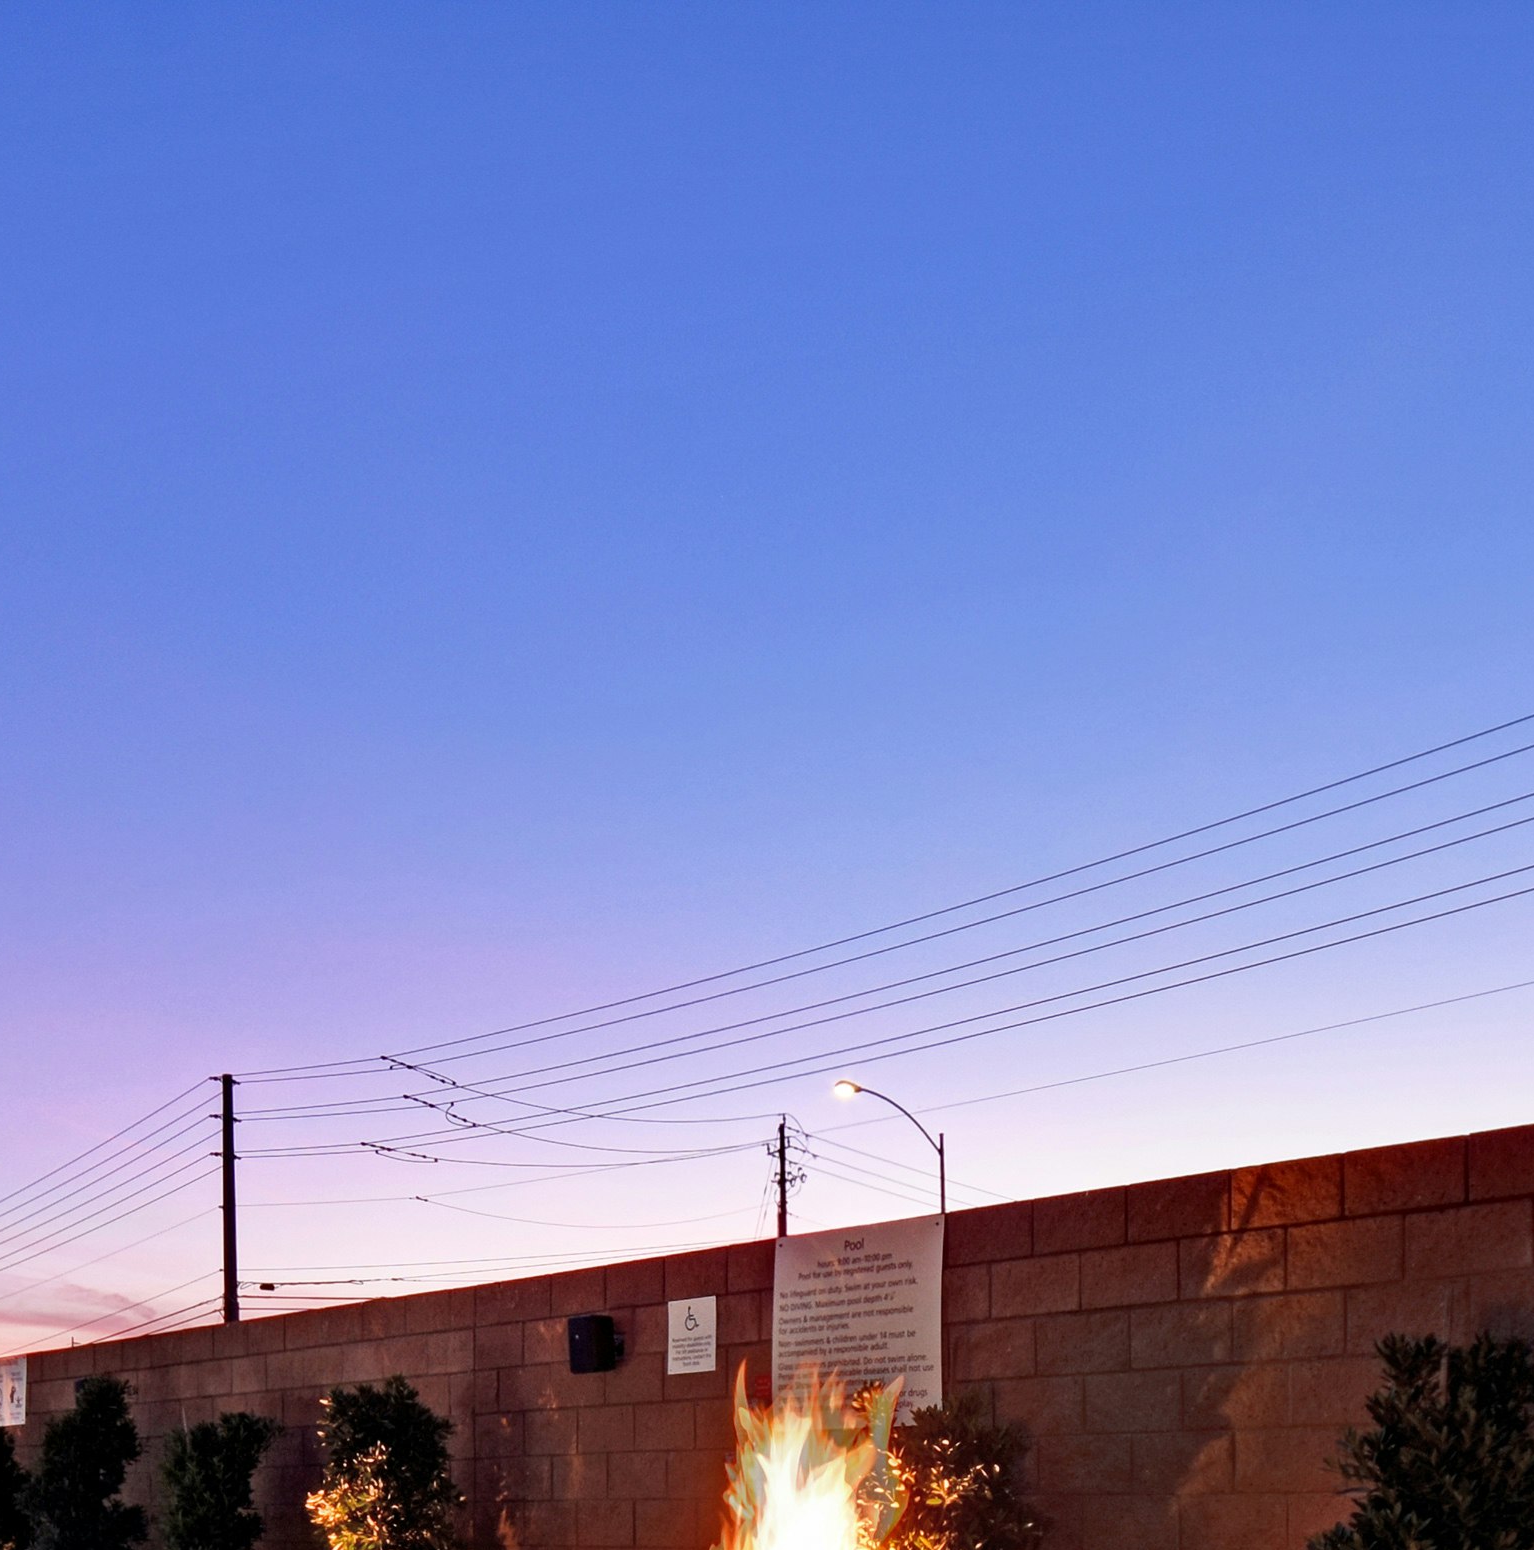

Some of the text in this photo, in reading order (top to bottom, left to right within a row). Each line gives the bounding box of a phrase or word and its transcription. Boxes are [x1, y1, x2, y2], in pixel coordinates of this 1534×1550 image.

[844, 1237, 865, 1252] Pool
[876, 1263, 896, 1273] guests
[844, 1283, 862, 1292] Swim
[863, 1282, 870, 1290] at
[871, 1280, 886, 1292] your
[888, 1279, 903, 1287] own
[851, 1311, 861, 1319] are
[863, 1309, 875, 1317] not
[876, 1305, 914, 1317] responsible
[832, 1334, 858, 1343] children
[859, 1332, 878, 1341] under
[880, 1330, 887, 1339] 14
[888, 1330, 905, 1339] must
[907, 1329, 916, 1338] be
[863, 1356, 873, 1365] Do
[874, 1355, 886, 1364] not
[888, 1355, 905, 1364] swim
[863, 1366, 890, 1375] diseases
[891, 1364, 907, 1374] shall
[908, 1363, 921, 1372] not
[922, 1363, 935, 1372] use
[908, 1388, 928, 1399] drugs
